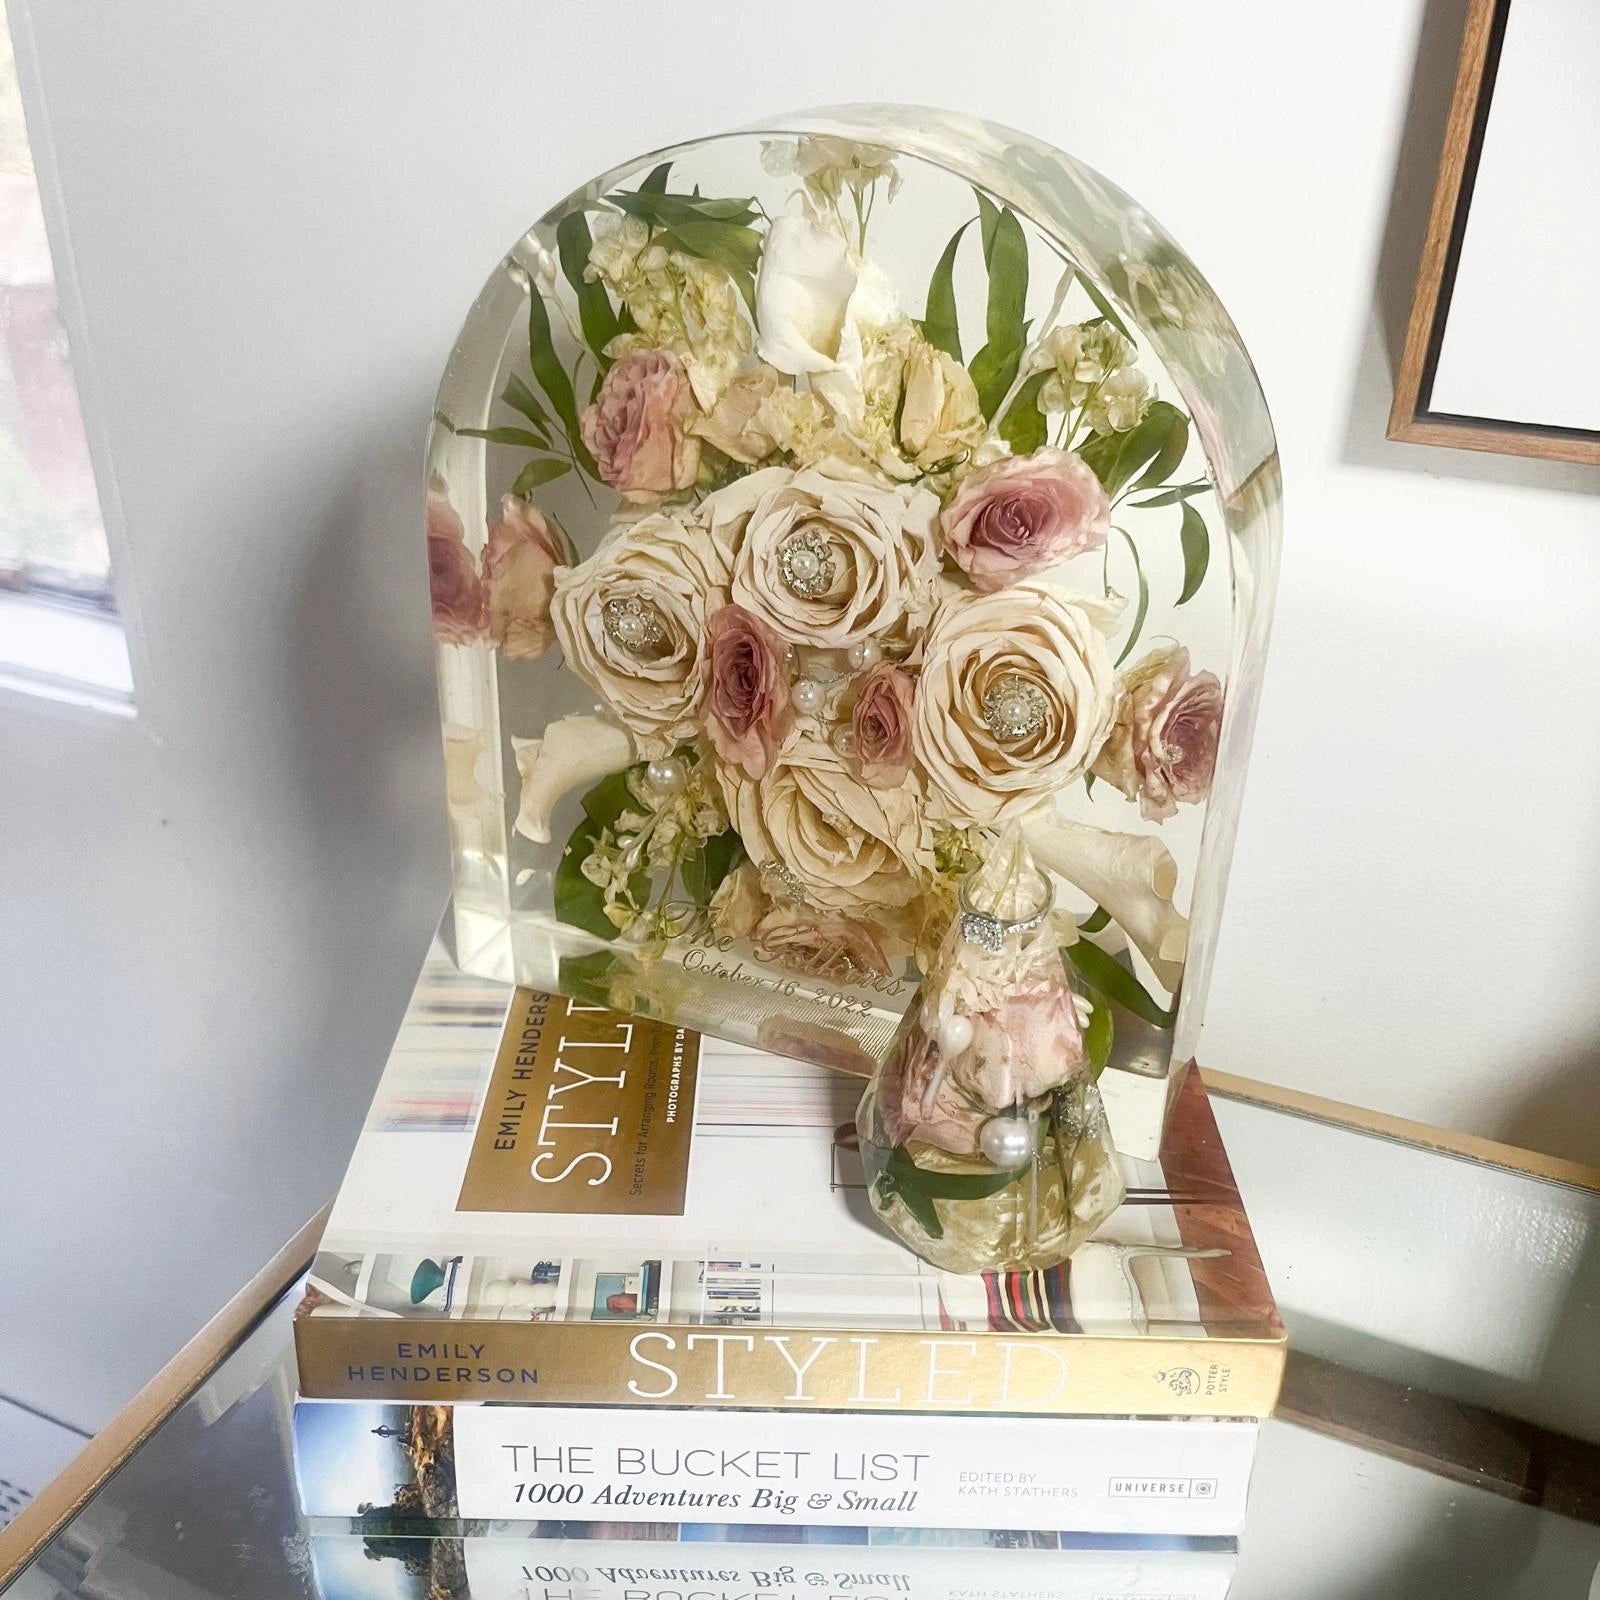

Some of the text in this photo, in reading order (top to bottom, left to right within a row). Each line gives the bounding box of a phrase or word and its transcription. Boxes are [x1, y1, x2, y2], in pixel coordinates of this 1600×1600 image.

[662, 899, 734, 952] The
[682, 948, 768, 987] October
[812, 987, 873, 1019] 2022
[674, 1041, 684, 1053] BY
[666, 1055, 683, 1124] PHOTOGRAPHS
[495, 1089, 527, 1150] EMILY
[637, 1091, 657, 1138] Arranging
[634, 1141, 648, 1155] for
[629, 1158, 646, 1196] Secrets
[396, 1342, 486, 1360] EMILY
[347, 1366, 540, 1384] HENDERSON
[626, 1332, 1069, 1405] STYLED
[1205, 1363, 1218, 1396] POTTER
[1219, 1367, 1231, 1393] STYLE
[501, 1445, 930, 1481] THE BUCKET LIST
[959, 1471, 1037, 1484] EDITED BY
[513, 1482, 918, 1515] 1000 Adventures Big & Small
[958, 1485, 1079, 1498] KATH STATHERS
[1115, 1481, 1186, 1495] UNIVERSE
